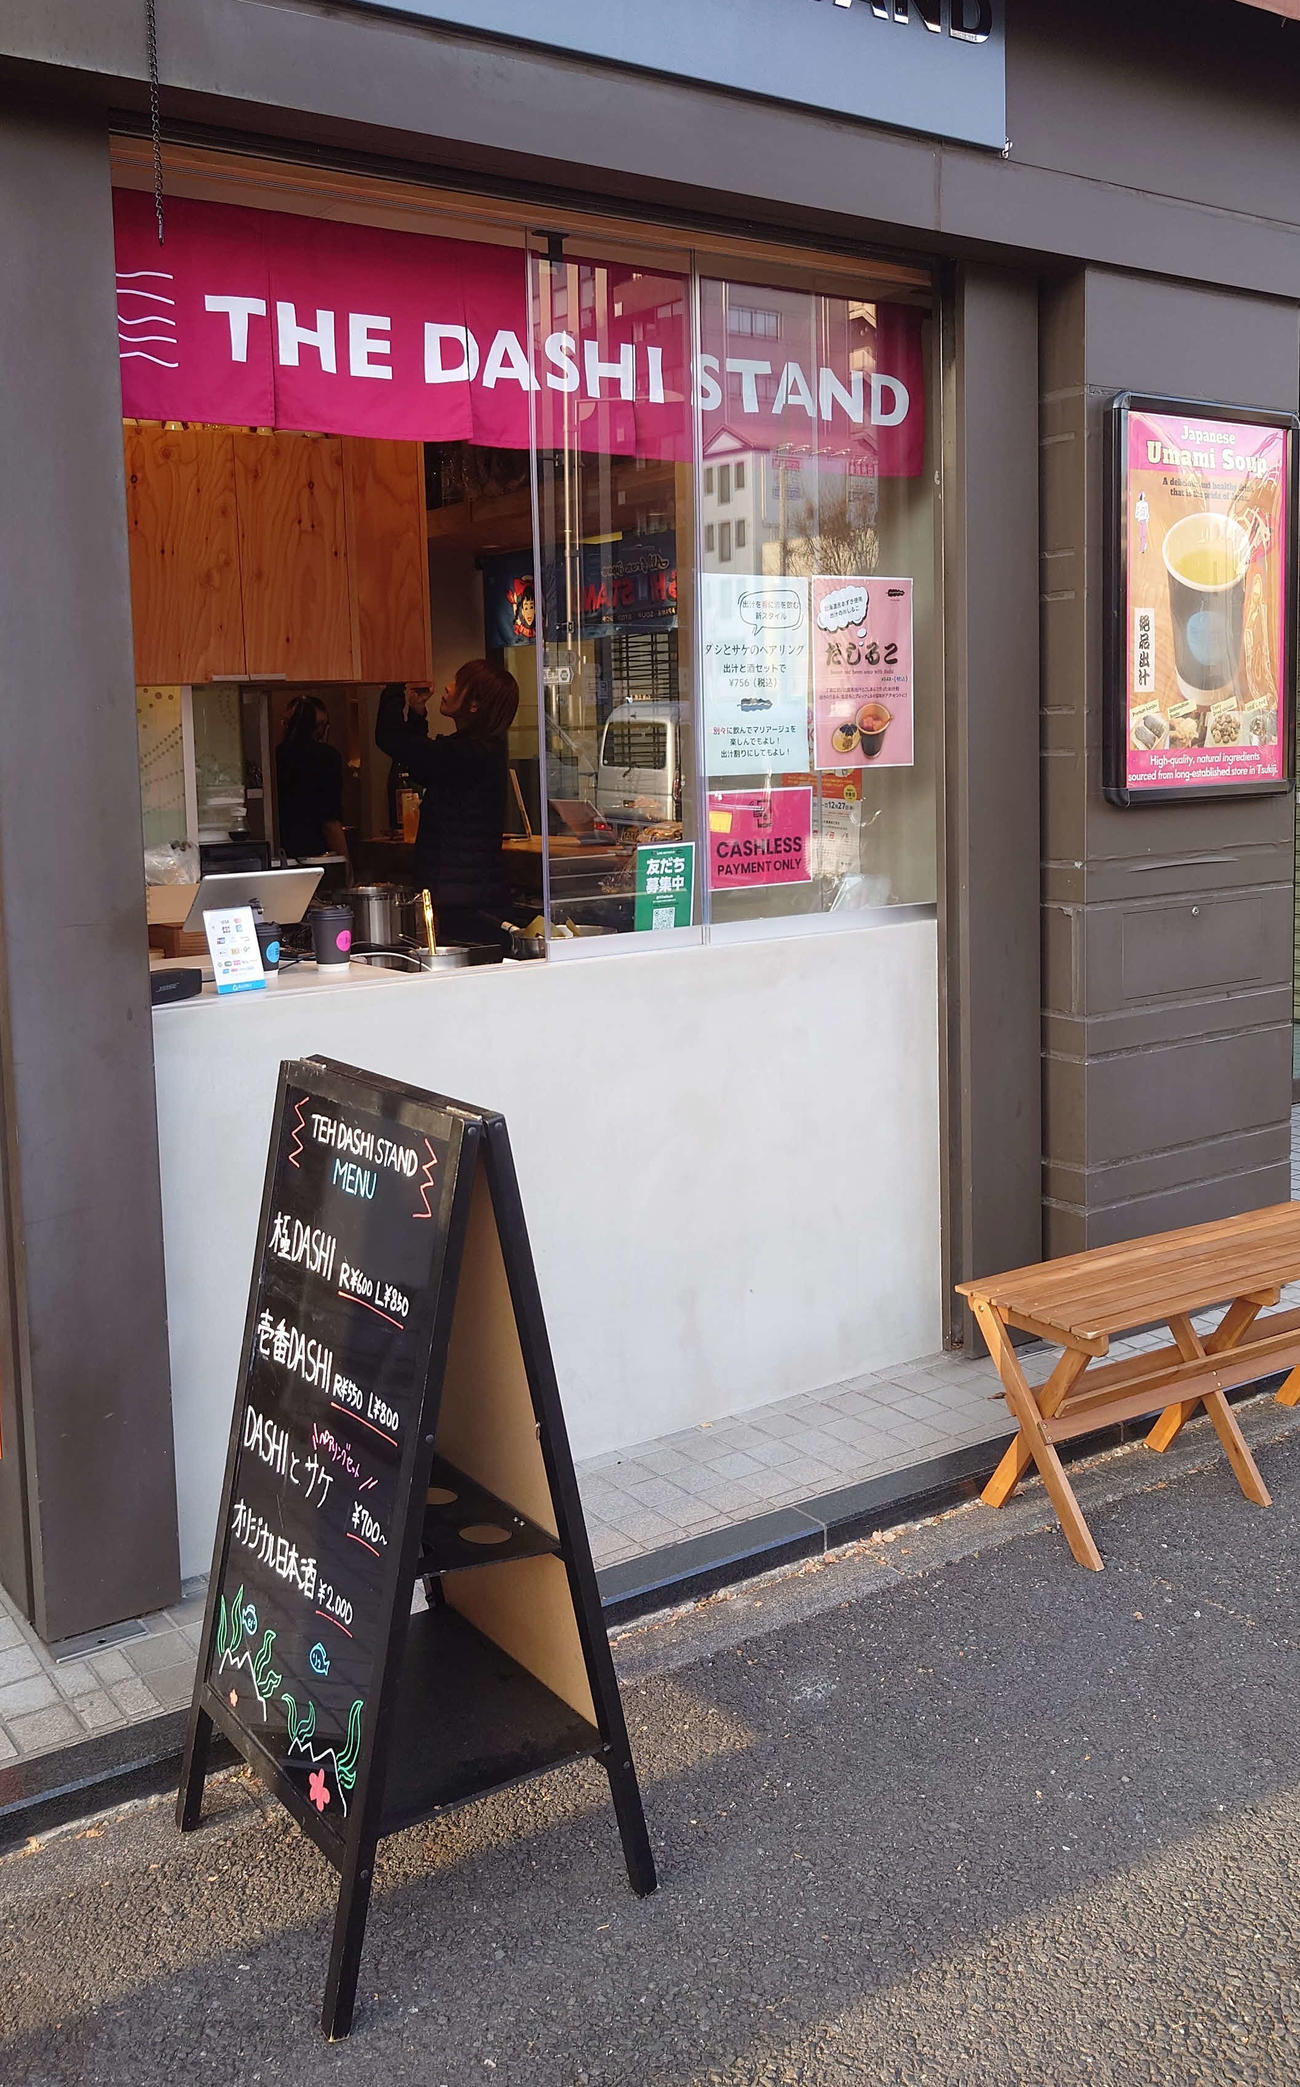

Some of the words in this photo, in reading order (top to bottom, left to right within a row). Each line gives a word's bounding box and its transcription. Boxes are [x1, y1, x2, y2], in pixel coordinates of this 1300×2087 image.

[204, 295, 393, 380] THE
[423, 322, 665, 404] DASHI
[689, 354, 910, 427] STAND
[1181, 425, 1236, 446] Japanese
[1146, 440, 1216, 470] Umami
[1222, 448, 1268, 478] Soup
[1162, 477, 1169, 486] A
[825, 642, 899, 666] だしるこ
[723, 663, 787, 674] 出汁と酒セットで
[713, 725, 796, 735] 別々に飲んでマリアージュを
[729, 736, 781, 746] 楽しんでもよし！
[720, 748, 790, 759] 出汁割りにしてもよし！
[1149, 754, 1195, 768] High-quality,
[1196, 753, 1222, 764] natural
[1222, 751, 1260, 765] ingredients
[1128, 769, 1157, 782] sourced
[1157, 769, 1174, 780] from
[1174, 765, 1231, 782] long-established
[1231, 765, 1248, 776] store
[1248, 765, 1256, 775] in
[716, 836, 802, 858] CASHLESS
[645, 857, 686, 875] 友だち
[717, 860, 772, 876] PAYMENT
[773, 858, 802, 871] ONLY
[645, 875, 685, 894] 募集中
[311, 1113, 337, 1148] TEH
[336, 1122, 375, 1160] DASHI
[374, 1137, 419, 1177] STAND
[332, 1158, 377, 1200] MENU
[268, 1211, 336, 1281] 極DASHI
[256, 1308, 333, 1394] 壱番DASHI
[231, 1498, 318, 1601] オリジナル日本酒
